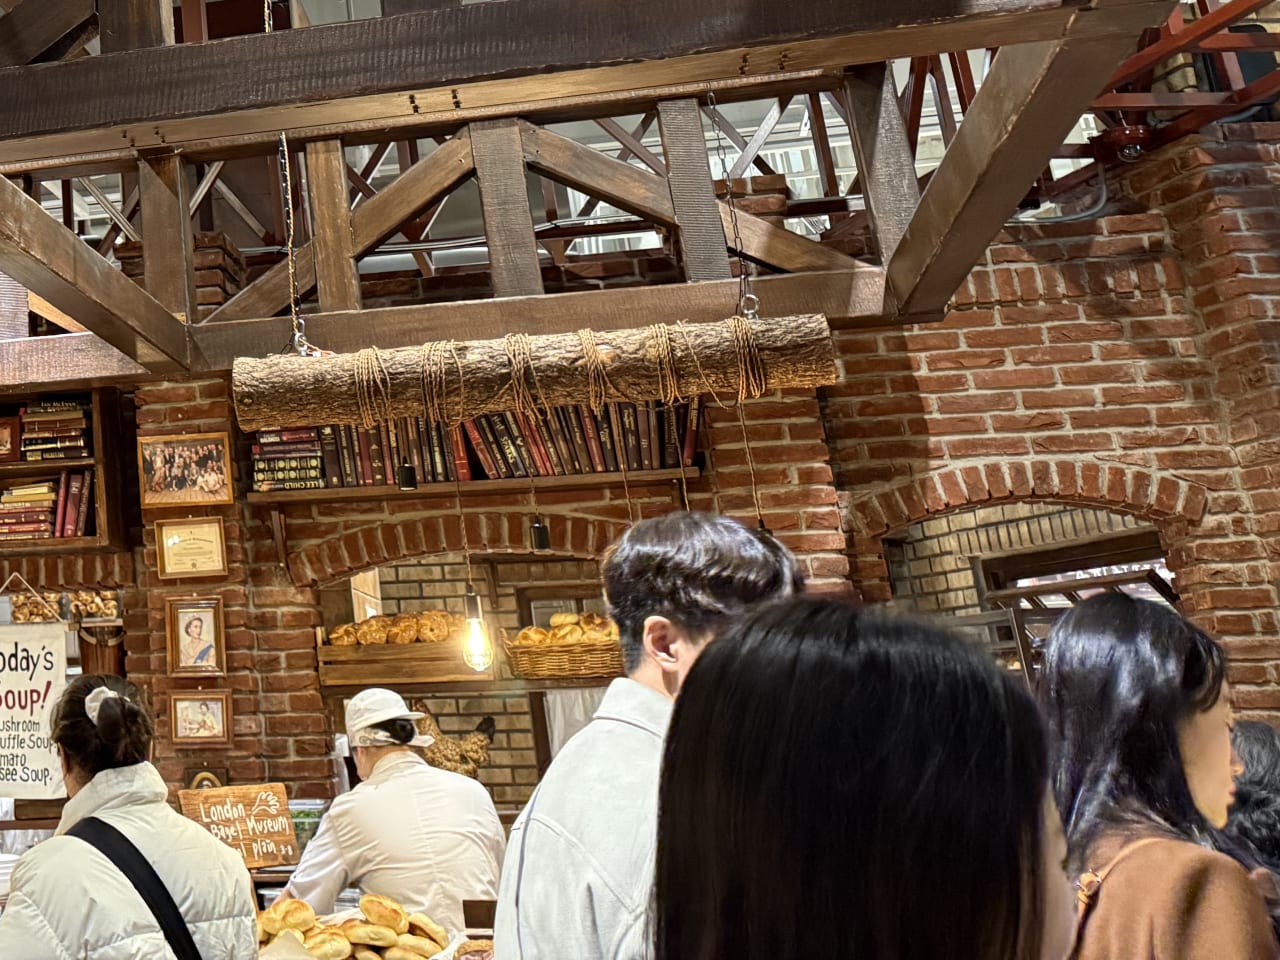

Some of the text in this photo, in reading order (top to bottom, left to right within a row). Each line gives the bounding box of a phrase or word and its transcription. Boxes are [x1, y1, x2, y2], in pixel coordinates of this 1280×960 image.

[19, 766, 53, 786] Soup.
[200, 798, 246, 822] London
[210, 816, 289, 842] Bagel Museum
[252, 838, 277, 861] plain
